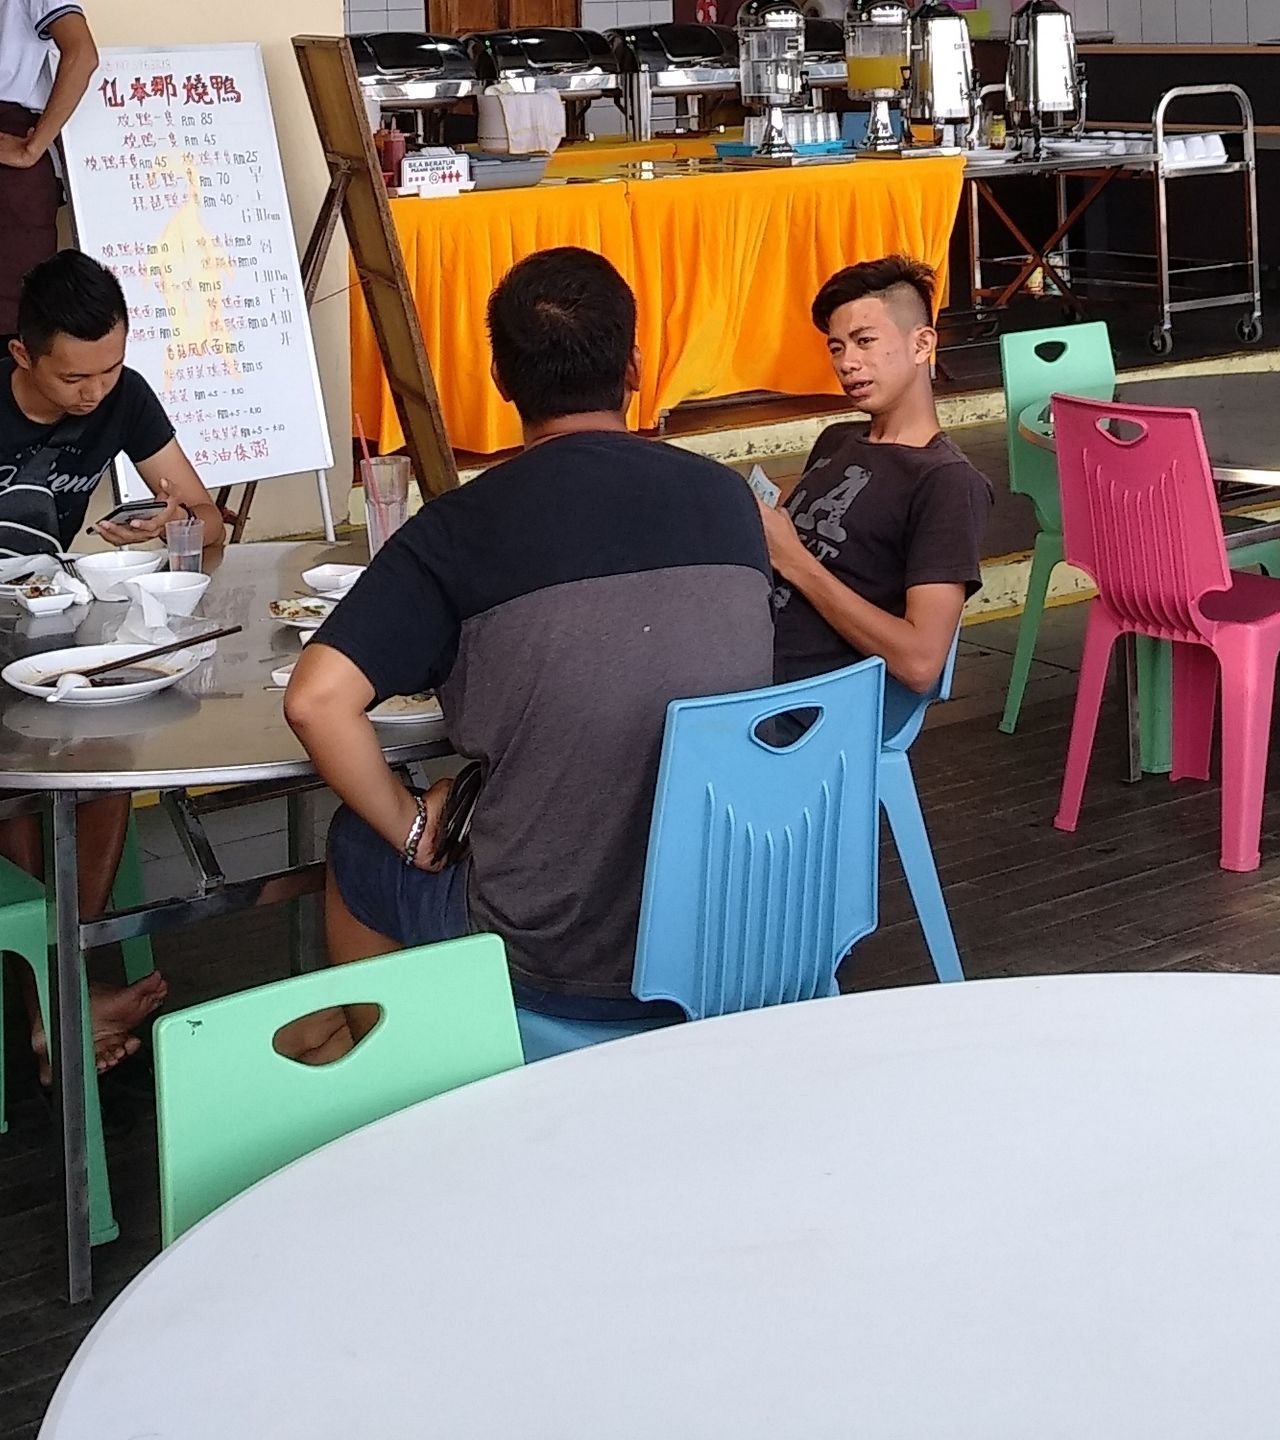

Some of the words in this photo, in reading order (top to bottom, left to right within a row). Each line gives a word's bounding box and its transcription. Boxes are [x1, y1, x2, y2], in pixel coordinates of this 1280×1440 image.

[200, 112, 214, 126] 85
[203, 134, 218, 147] 45
[216, 172, 231, 186] 70
